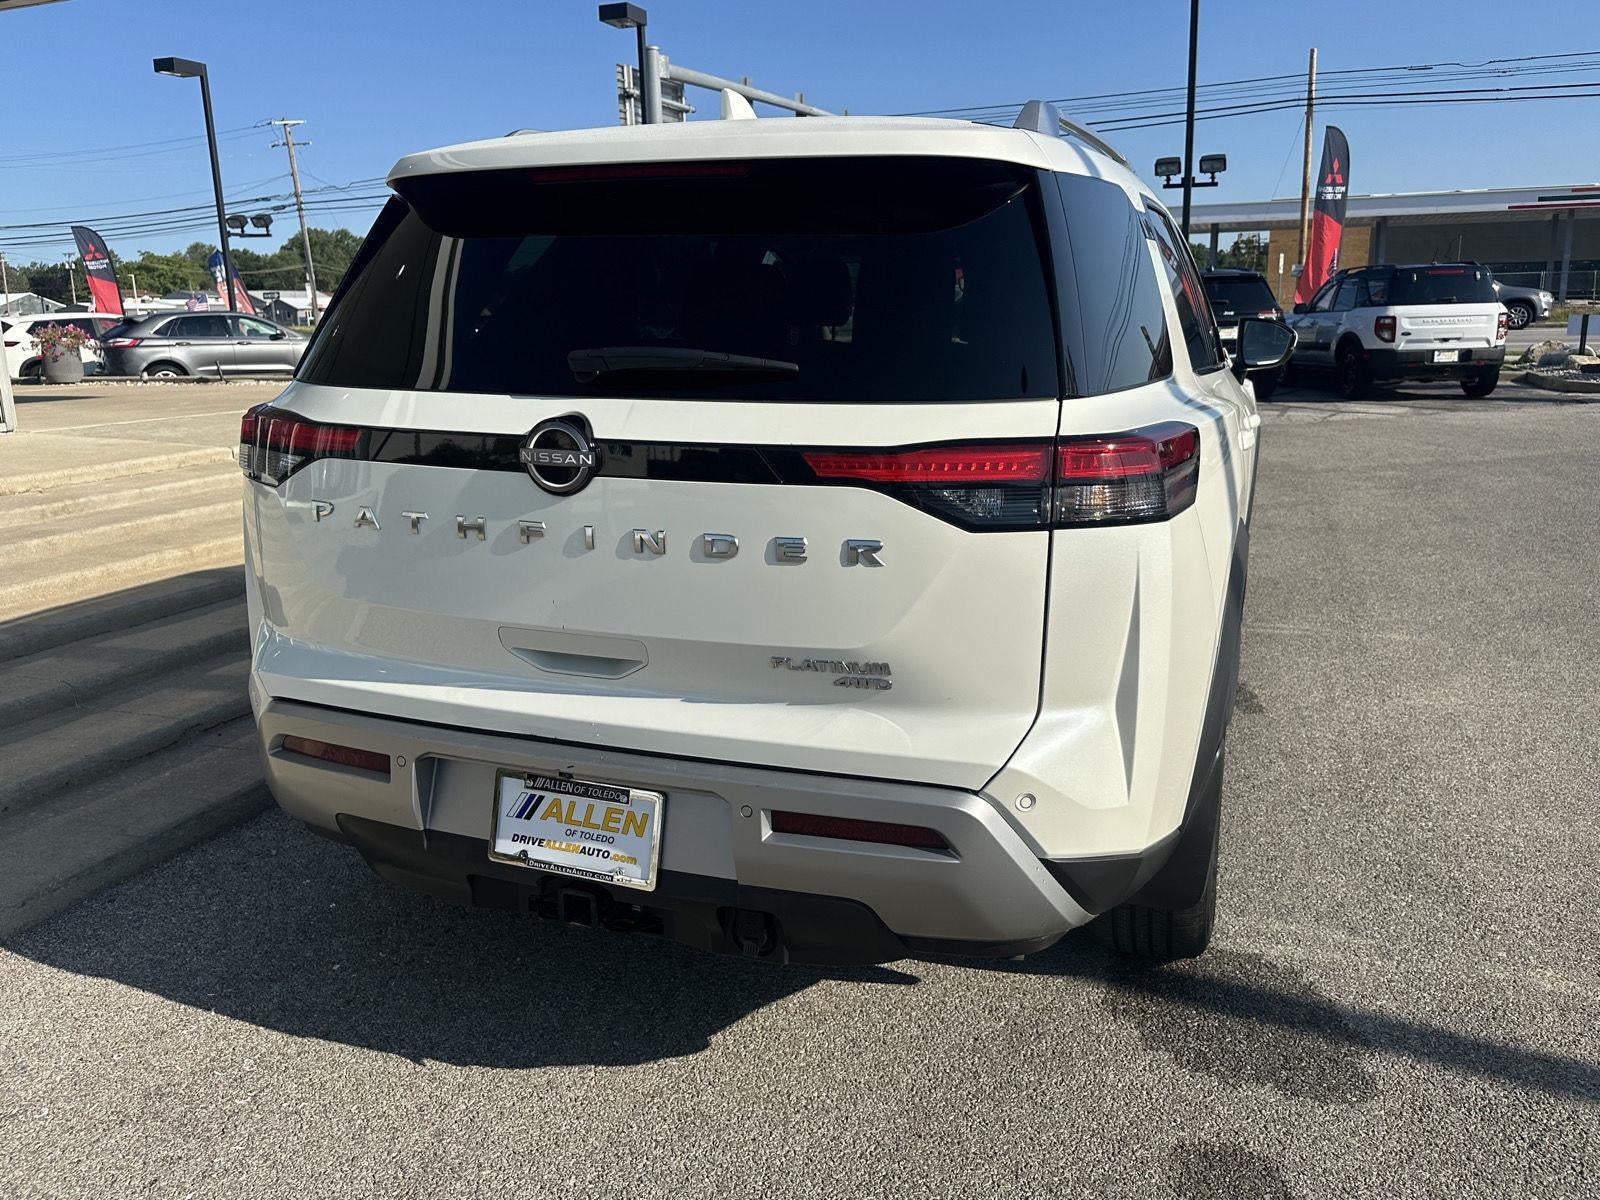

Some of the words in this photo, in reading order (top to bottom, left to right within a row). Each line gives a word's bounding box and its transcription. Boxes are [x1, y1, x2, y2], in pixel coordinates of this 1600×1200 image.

[521, 451, 592, 465] NISSAN
[310, 499, 888, 568] PATHFINDER
[770, 656, 893, 676] PLATINUM
[833, 676, 893, 691] 4WD
[545, 778, 574, 793] ALLEN
[573, 784, 586, 794] OF
[587, 788, 622, 801] TOLEDO
[540, 797, 650, 838] ALLEN
[565, 828, 577, 837] OF
[579, 830, 615, 844] TOLEDO
